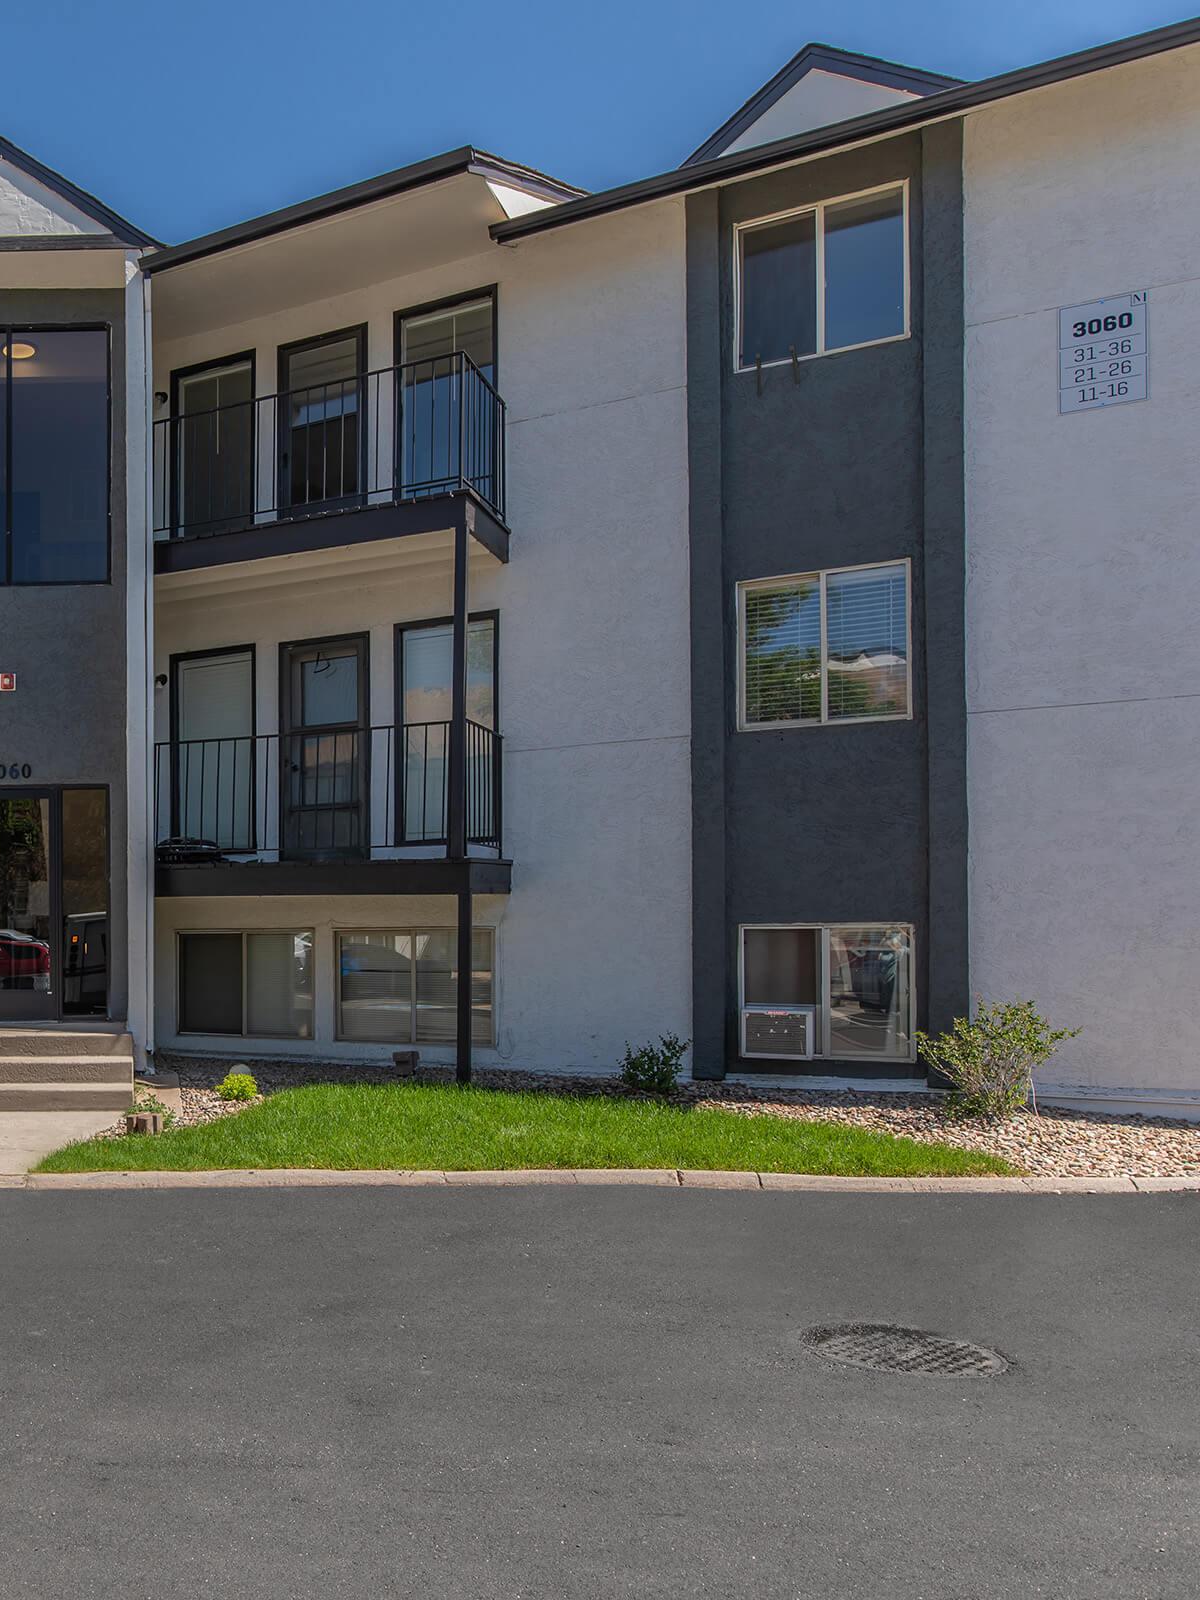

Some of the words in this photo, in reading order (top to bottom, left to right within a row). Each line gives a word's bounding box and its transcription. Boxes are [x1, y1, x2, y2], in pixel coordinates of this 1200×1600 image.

[1072, 312, 1133, 338] 3060
[1074, 339, 1132, 363] 31-36
[1074, 360, 1132, 383] 21-26
[1078, 381, 1128, 403] 11-16
